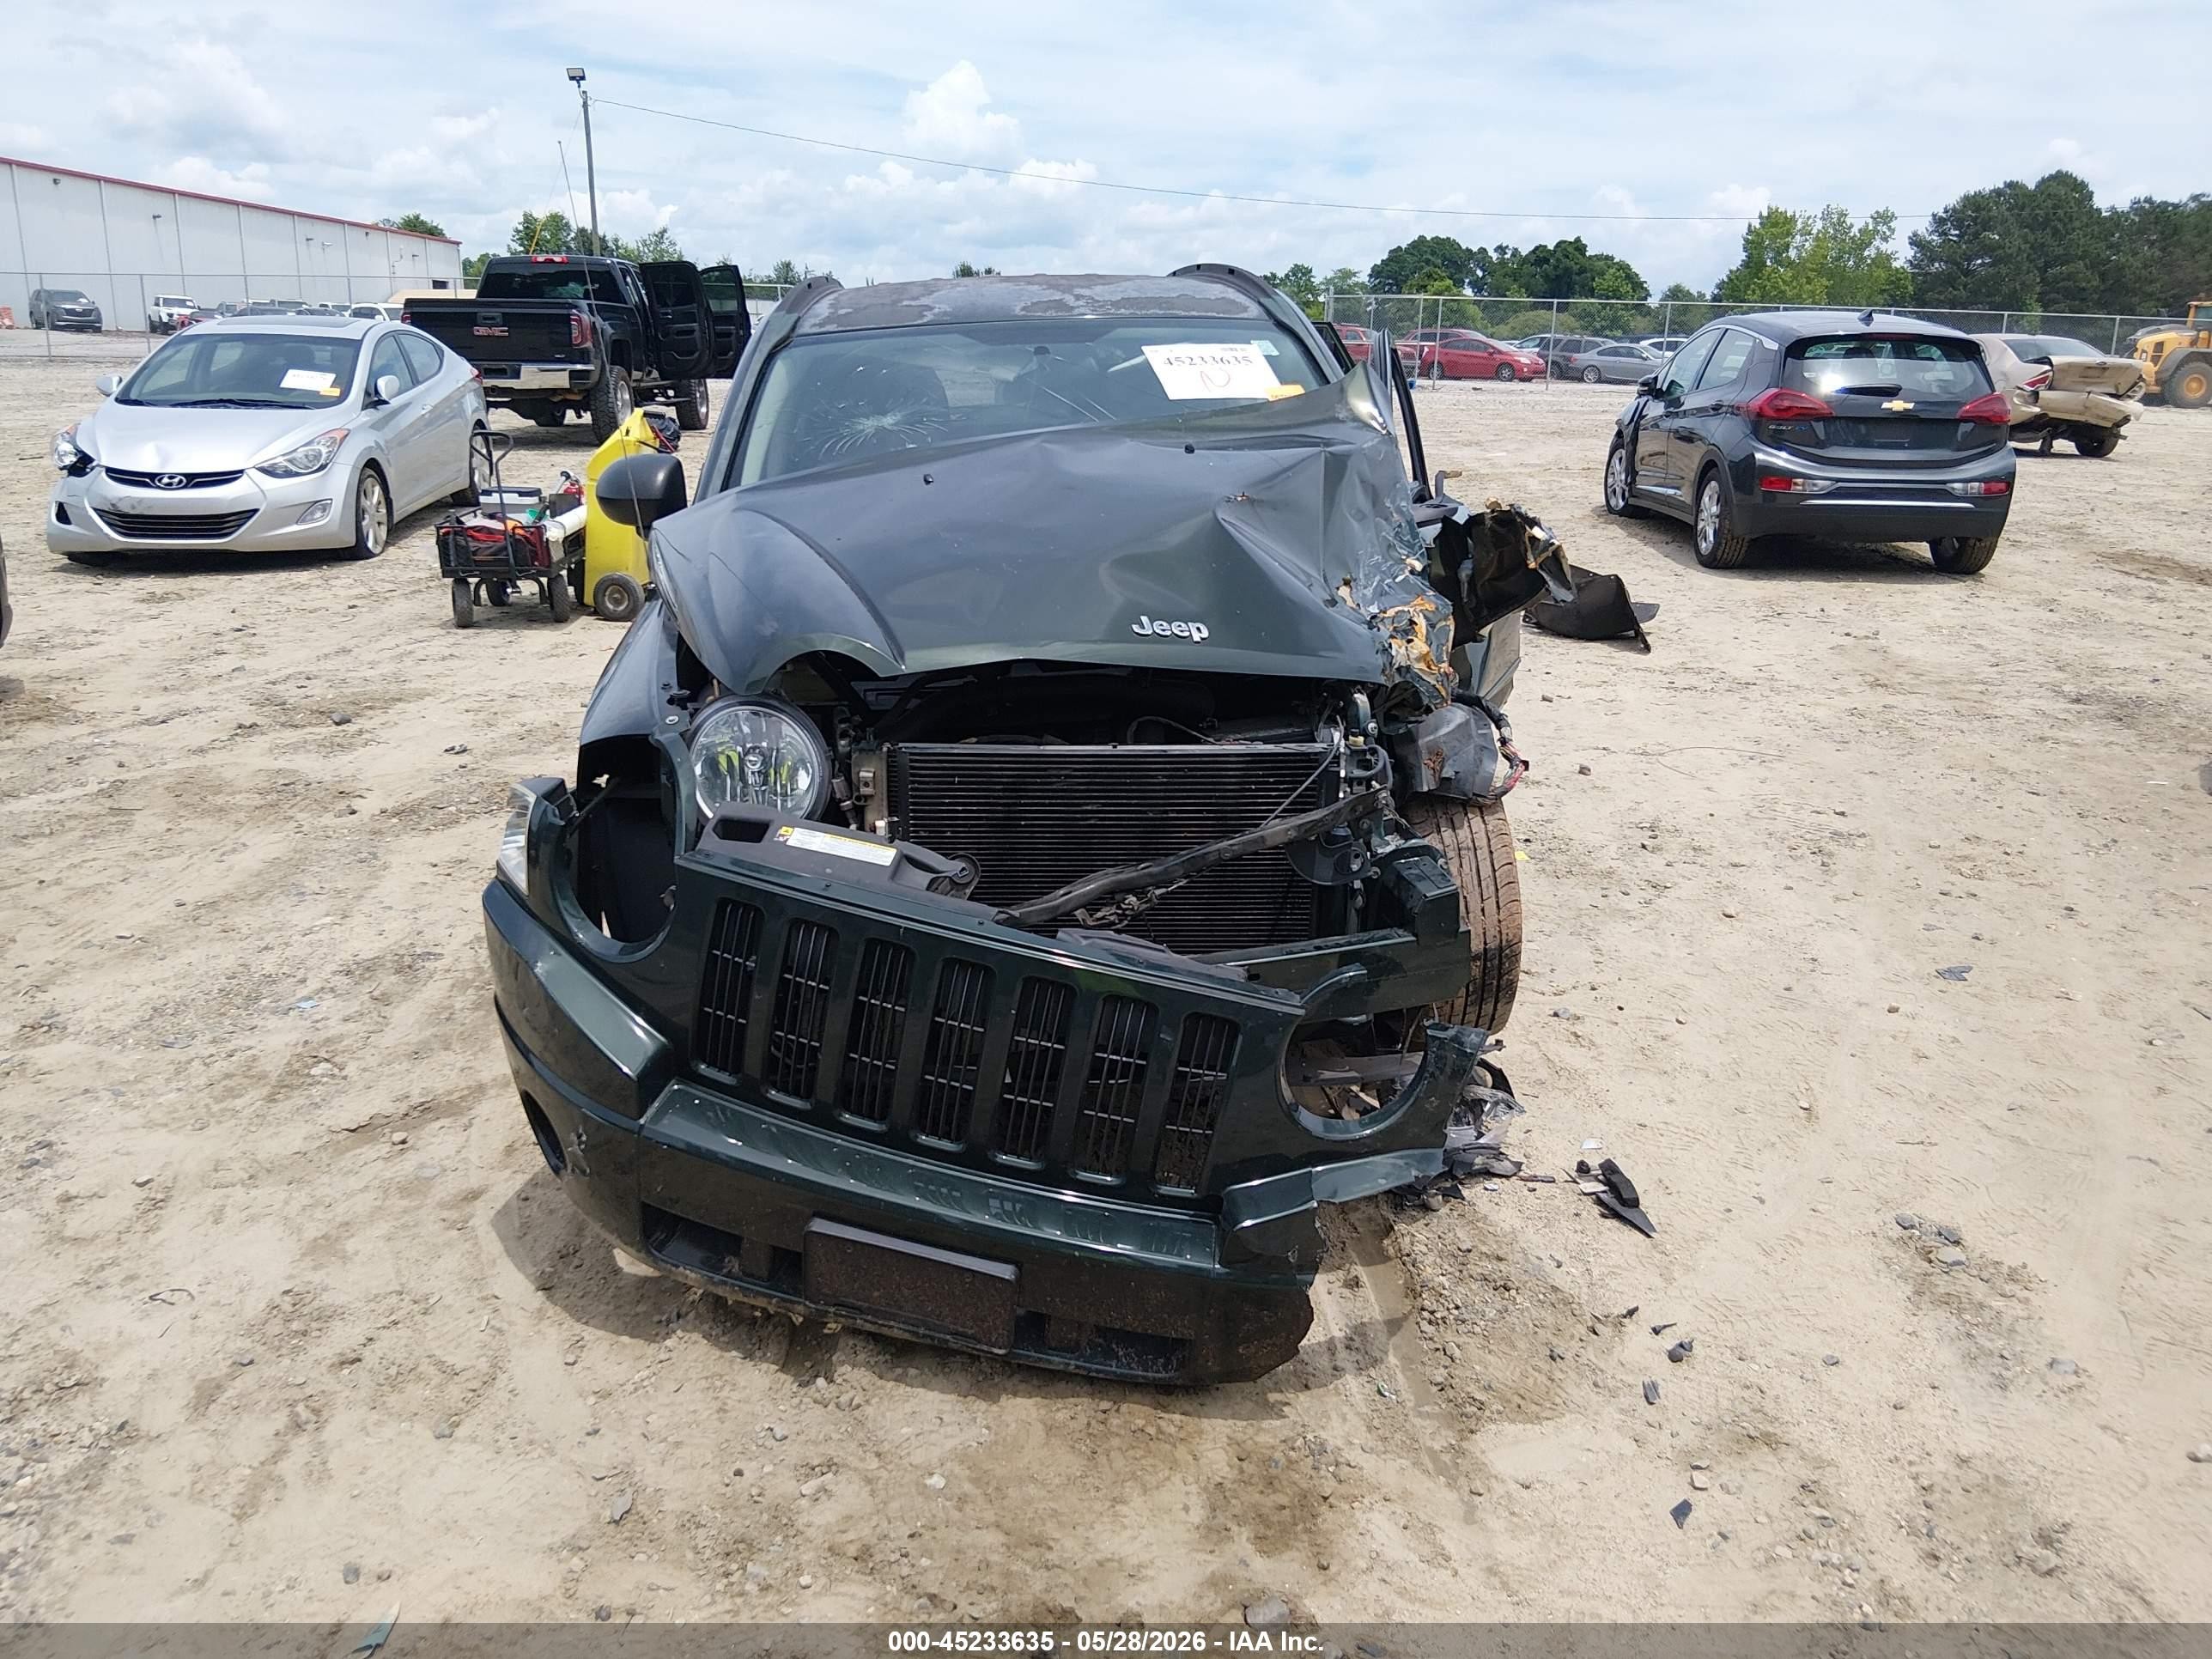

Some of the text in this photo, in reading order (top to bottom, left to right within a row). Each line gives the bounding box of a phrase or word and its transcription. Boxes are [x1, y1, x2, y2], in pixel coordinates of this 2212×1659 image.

[473, 326, 509, 337] GMC
[1164, 355, 1253, 367] 45233635
[1131, 616, 1210, 643] Jeep
